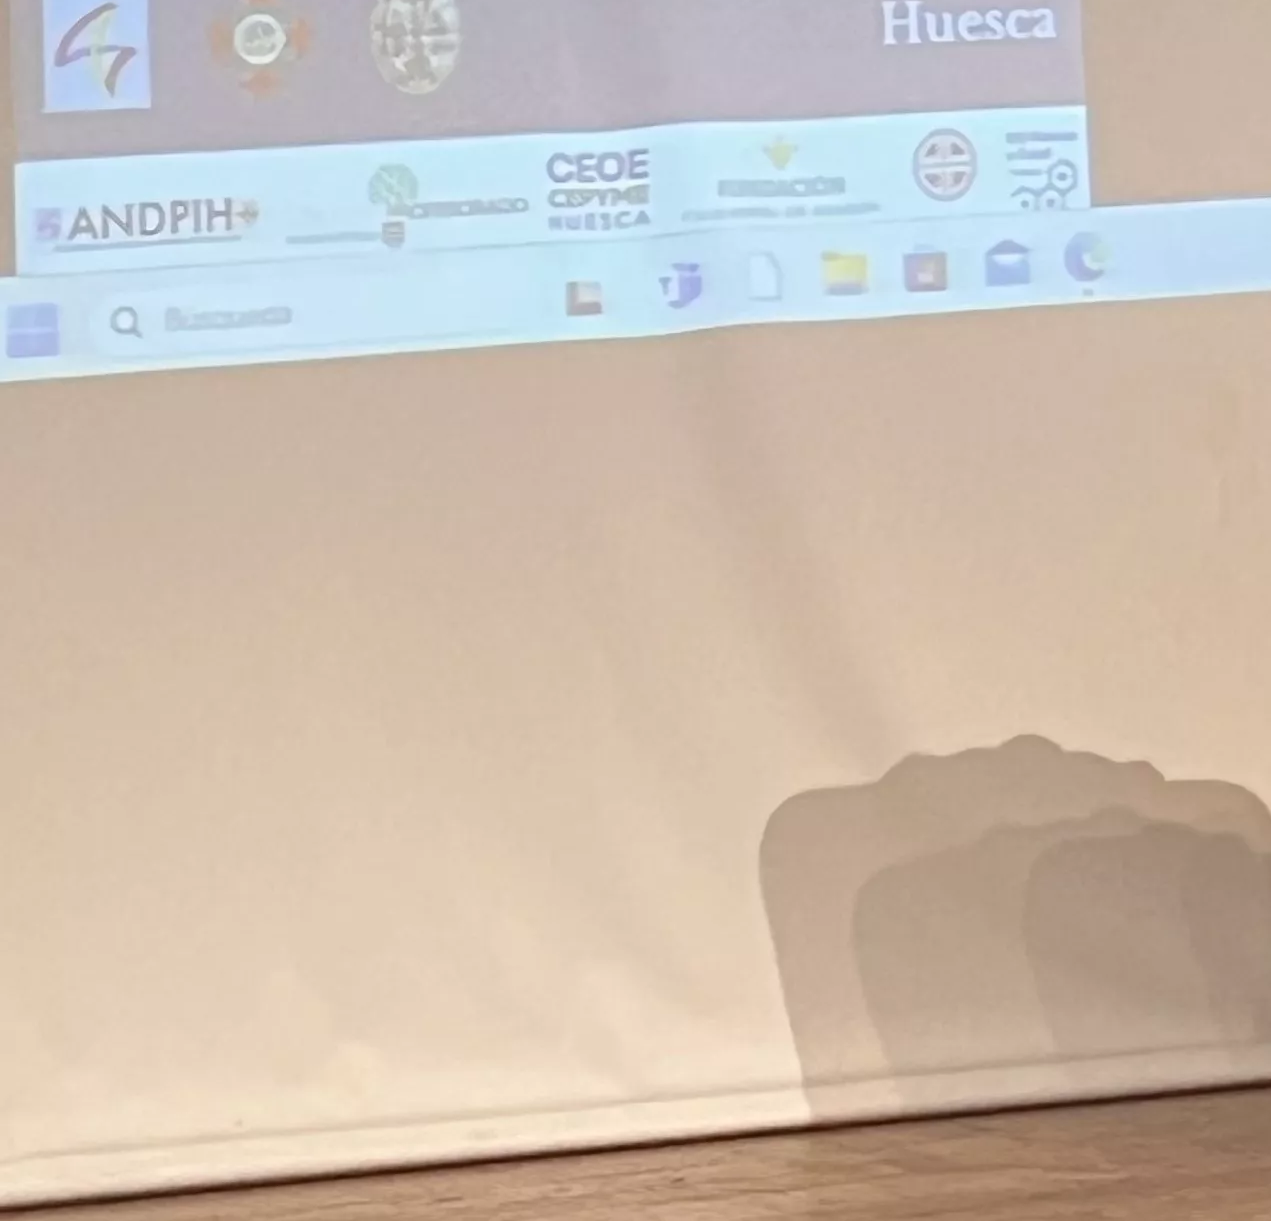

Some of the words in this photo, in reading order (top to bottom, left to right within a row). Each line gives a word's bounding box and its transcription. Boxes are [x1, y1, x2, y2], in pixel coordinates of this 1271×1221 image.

[882, 0, 1057, 45] Huesca
[546, 148, 650, 183] CEOE
[67, 198, 233, 240] ANDPIH
